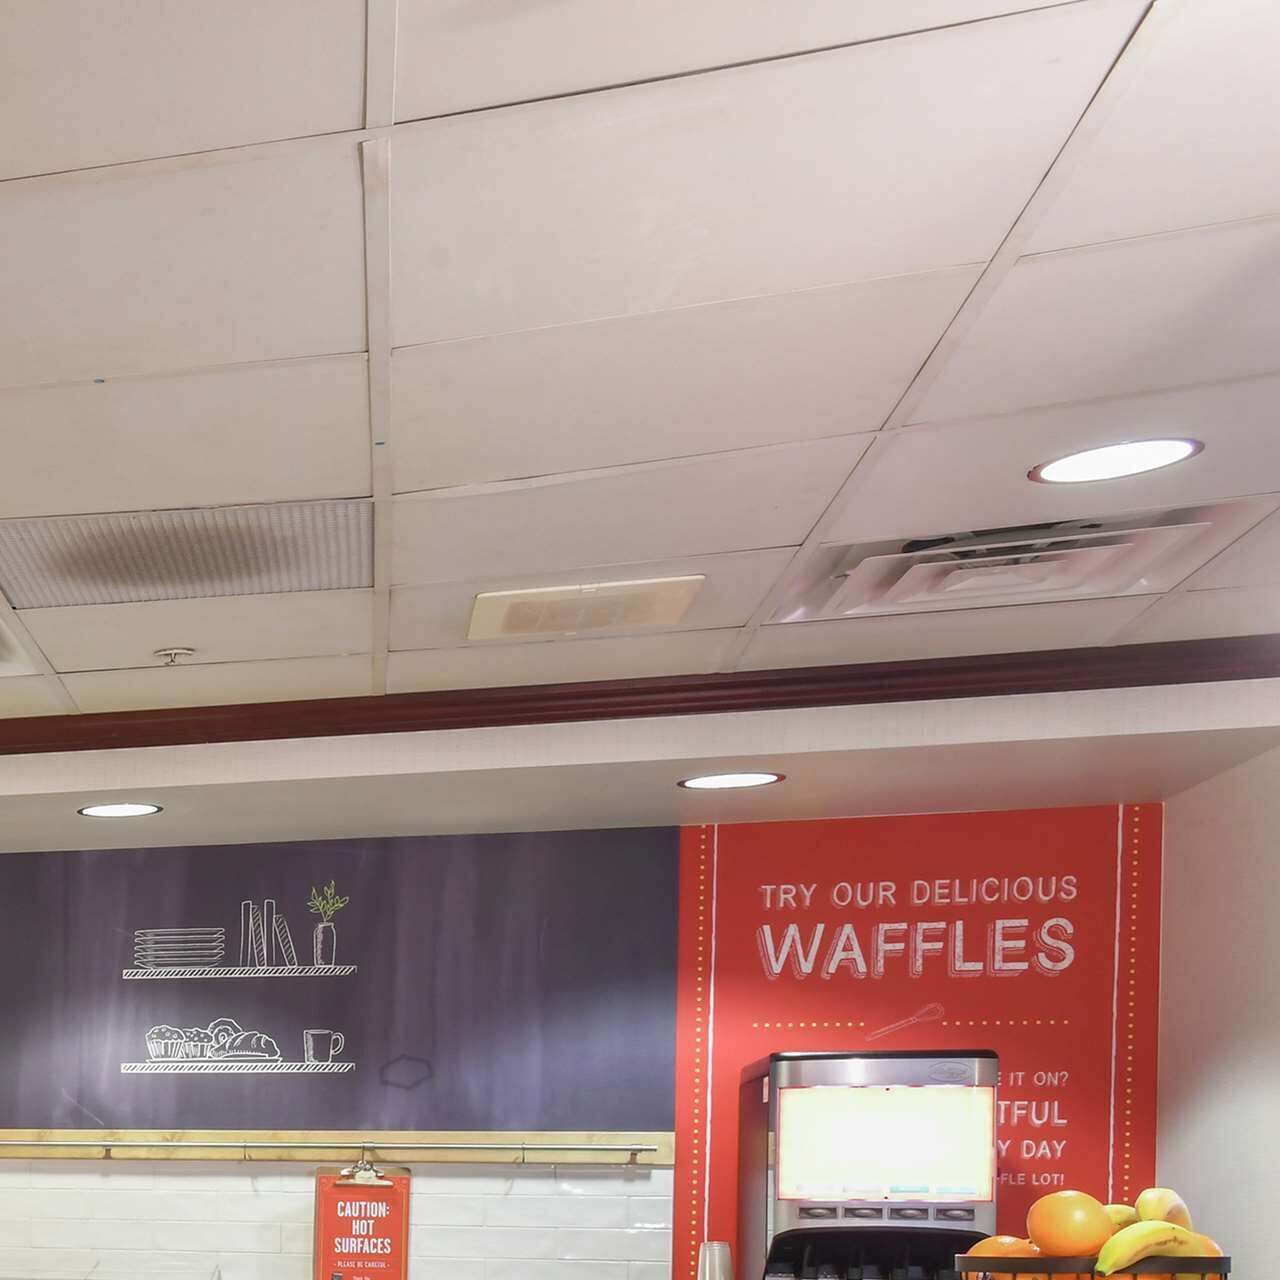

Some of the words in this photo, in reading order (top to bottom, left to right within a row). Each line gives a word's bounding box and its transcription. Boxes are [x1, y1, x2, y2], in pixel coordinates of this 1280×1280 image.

[761, 884, 817, 909] TRY
[831, 881, 897, 907] OUR
[911, 875, 1078, 905] DELICIOUS
[757, 917, 1076, 980] WAFFLES
[1009, 1071, 1026, 1087] IT
[1033, 1070, 1069, 1088] ON?
[997, 1100, 1068, 1128] TFUL
[1021, 1139, 1067, 1159] DAY
[1031, 1172, 1065, 1186] LOT!
[337, 1201, 390, 1218] CAUTION:
[352, 1219, 375, 1236] HOT
[334, 1237, 392, 1254] SURFACES
